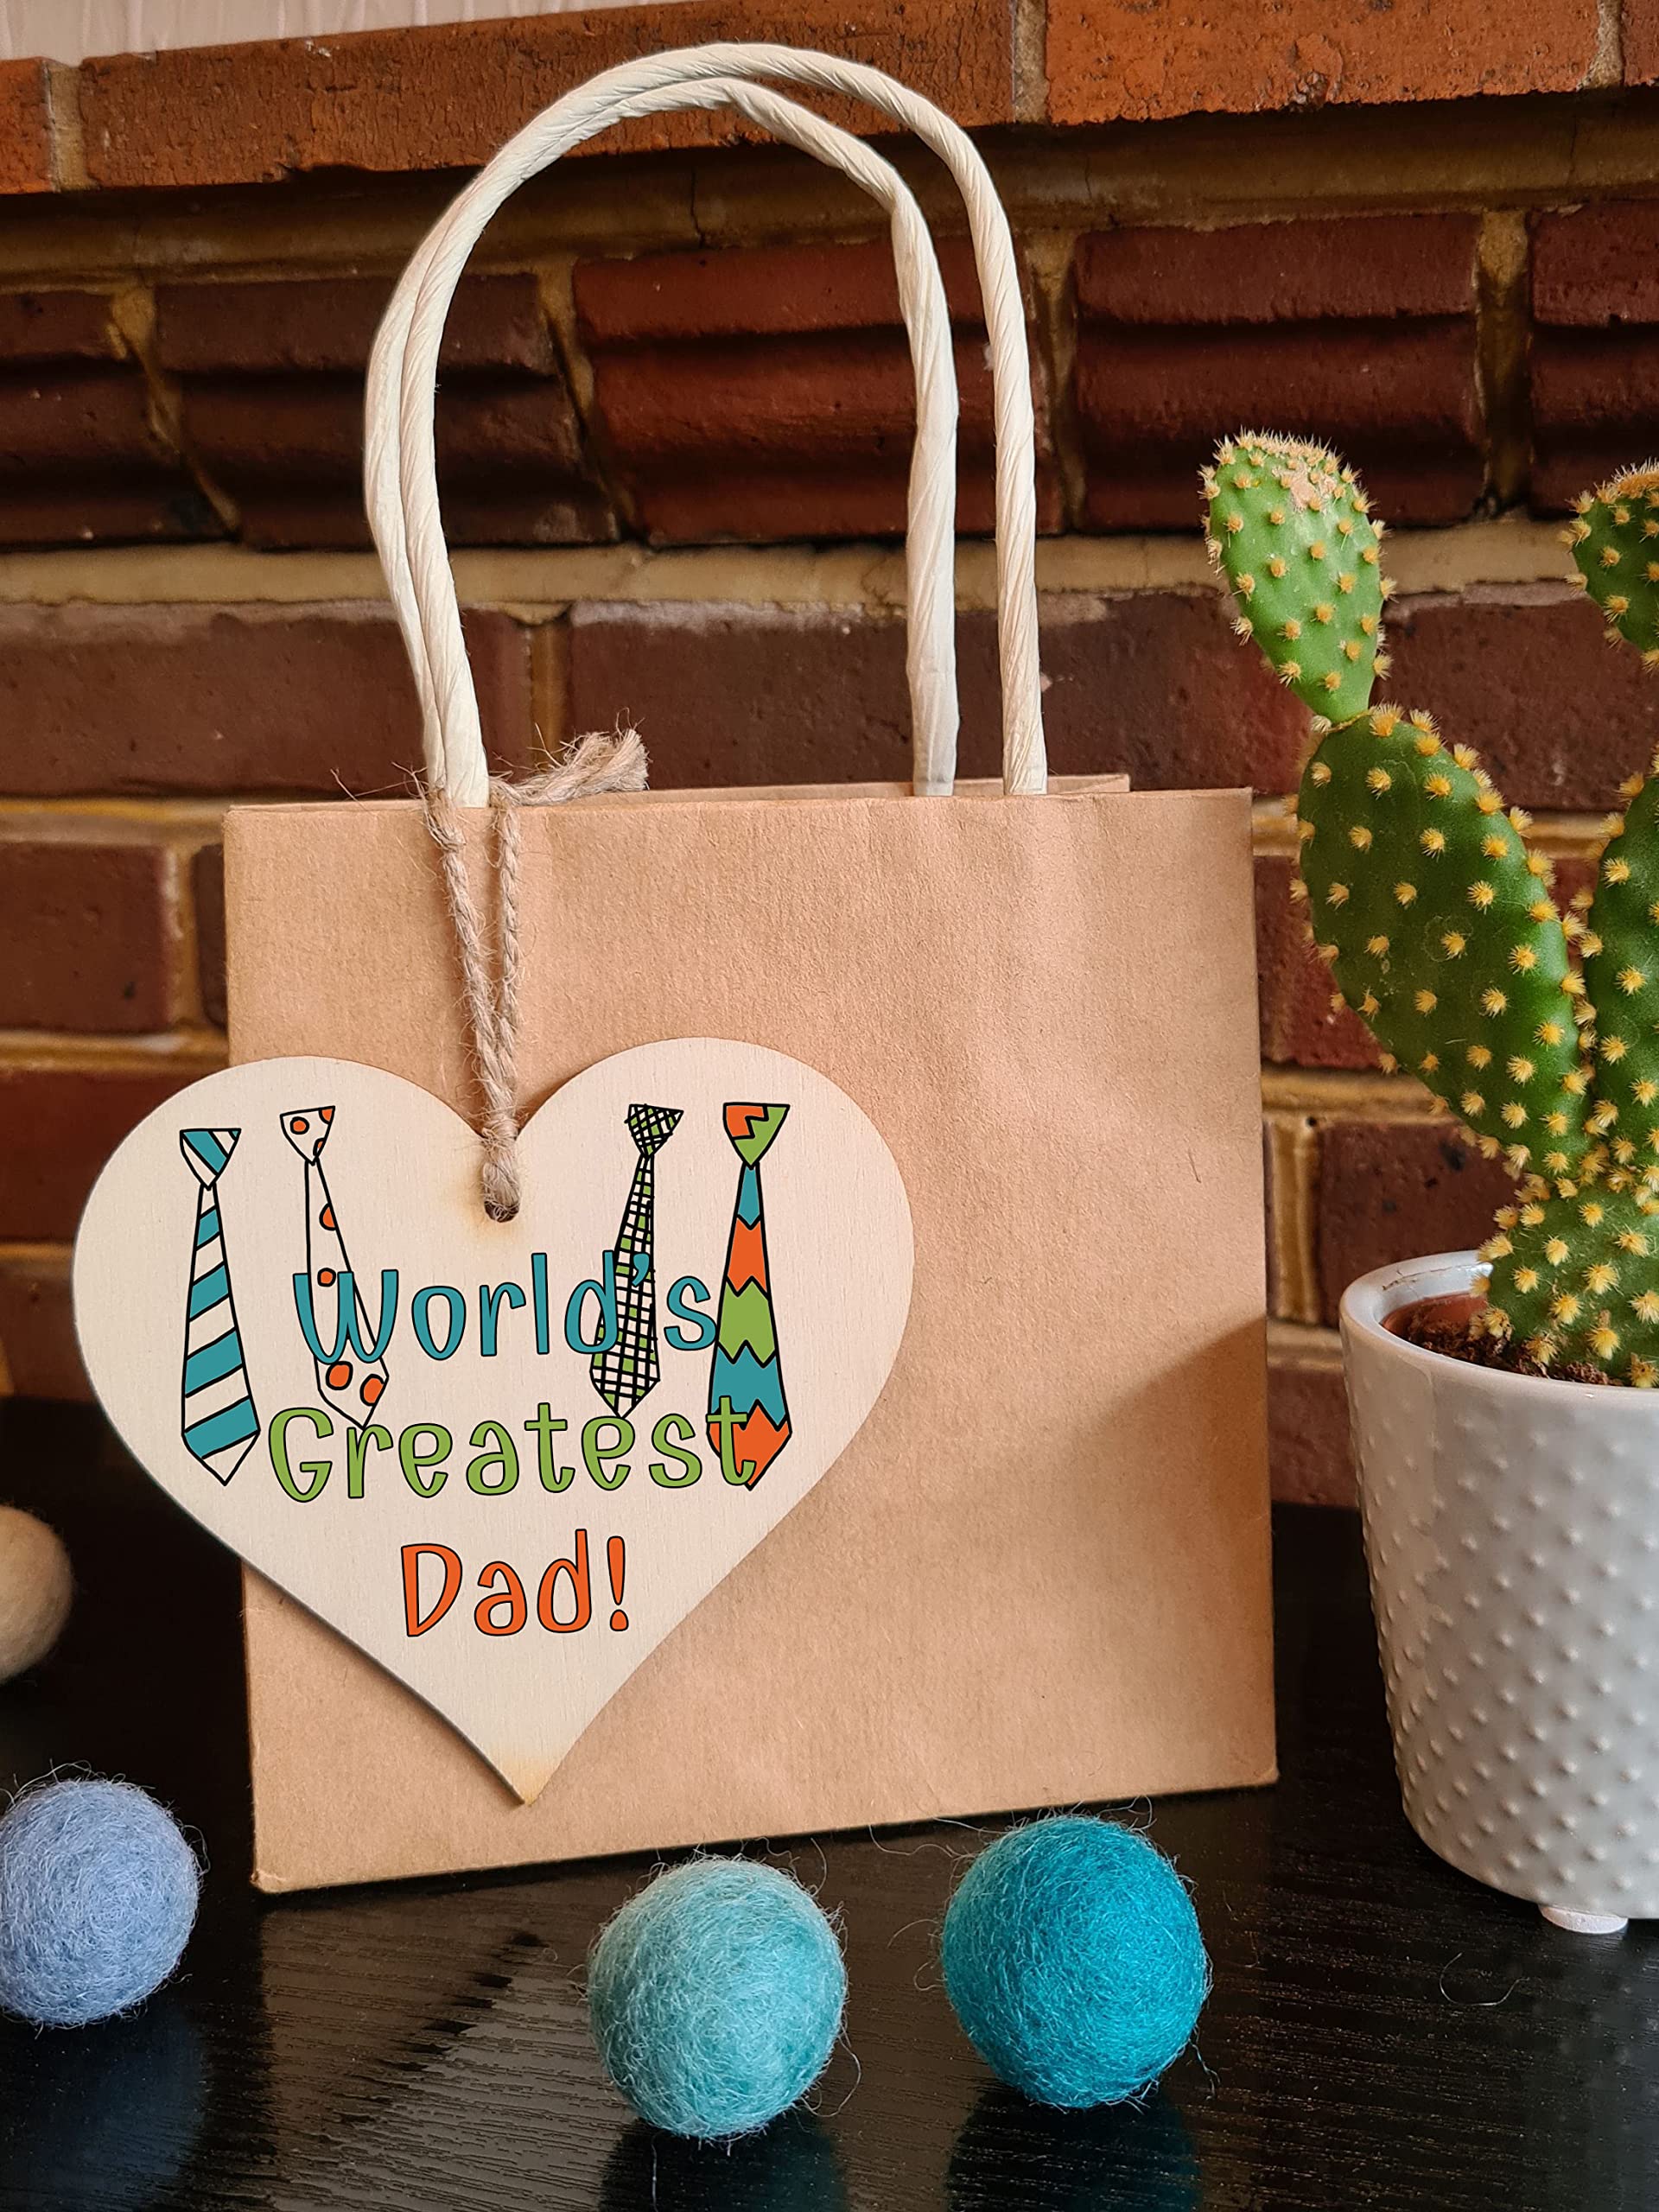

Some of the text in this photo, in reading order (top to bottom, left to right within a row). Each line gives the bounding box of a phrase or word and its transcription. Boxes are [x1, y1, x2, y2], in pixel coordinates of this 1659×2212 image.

[293, 1250, 717, 1363] World's
[268, 1395, 758, 1503] Greatest
[401, 1529, 628, 1637] Dad!
